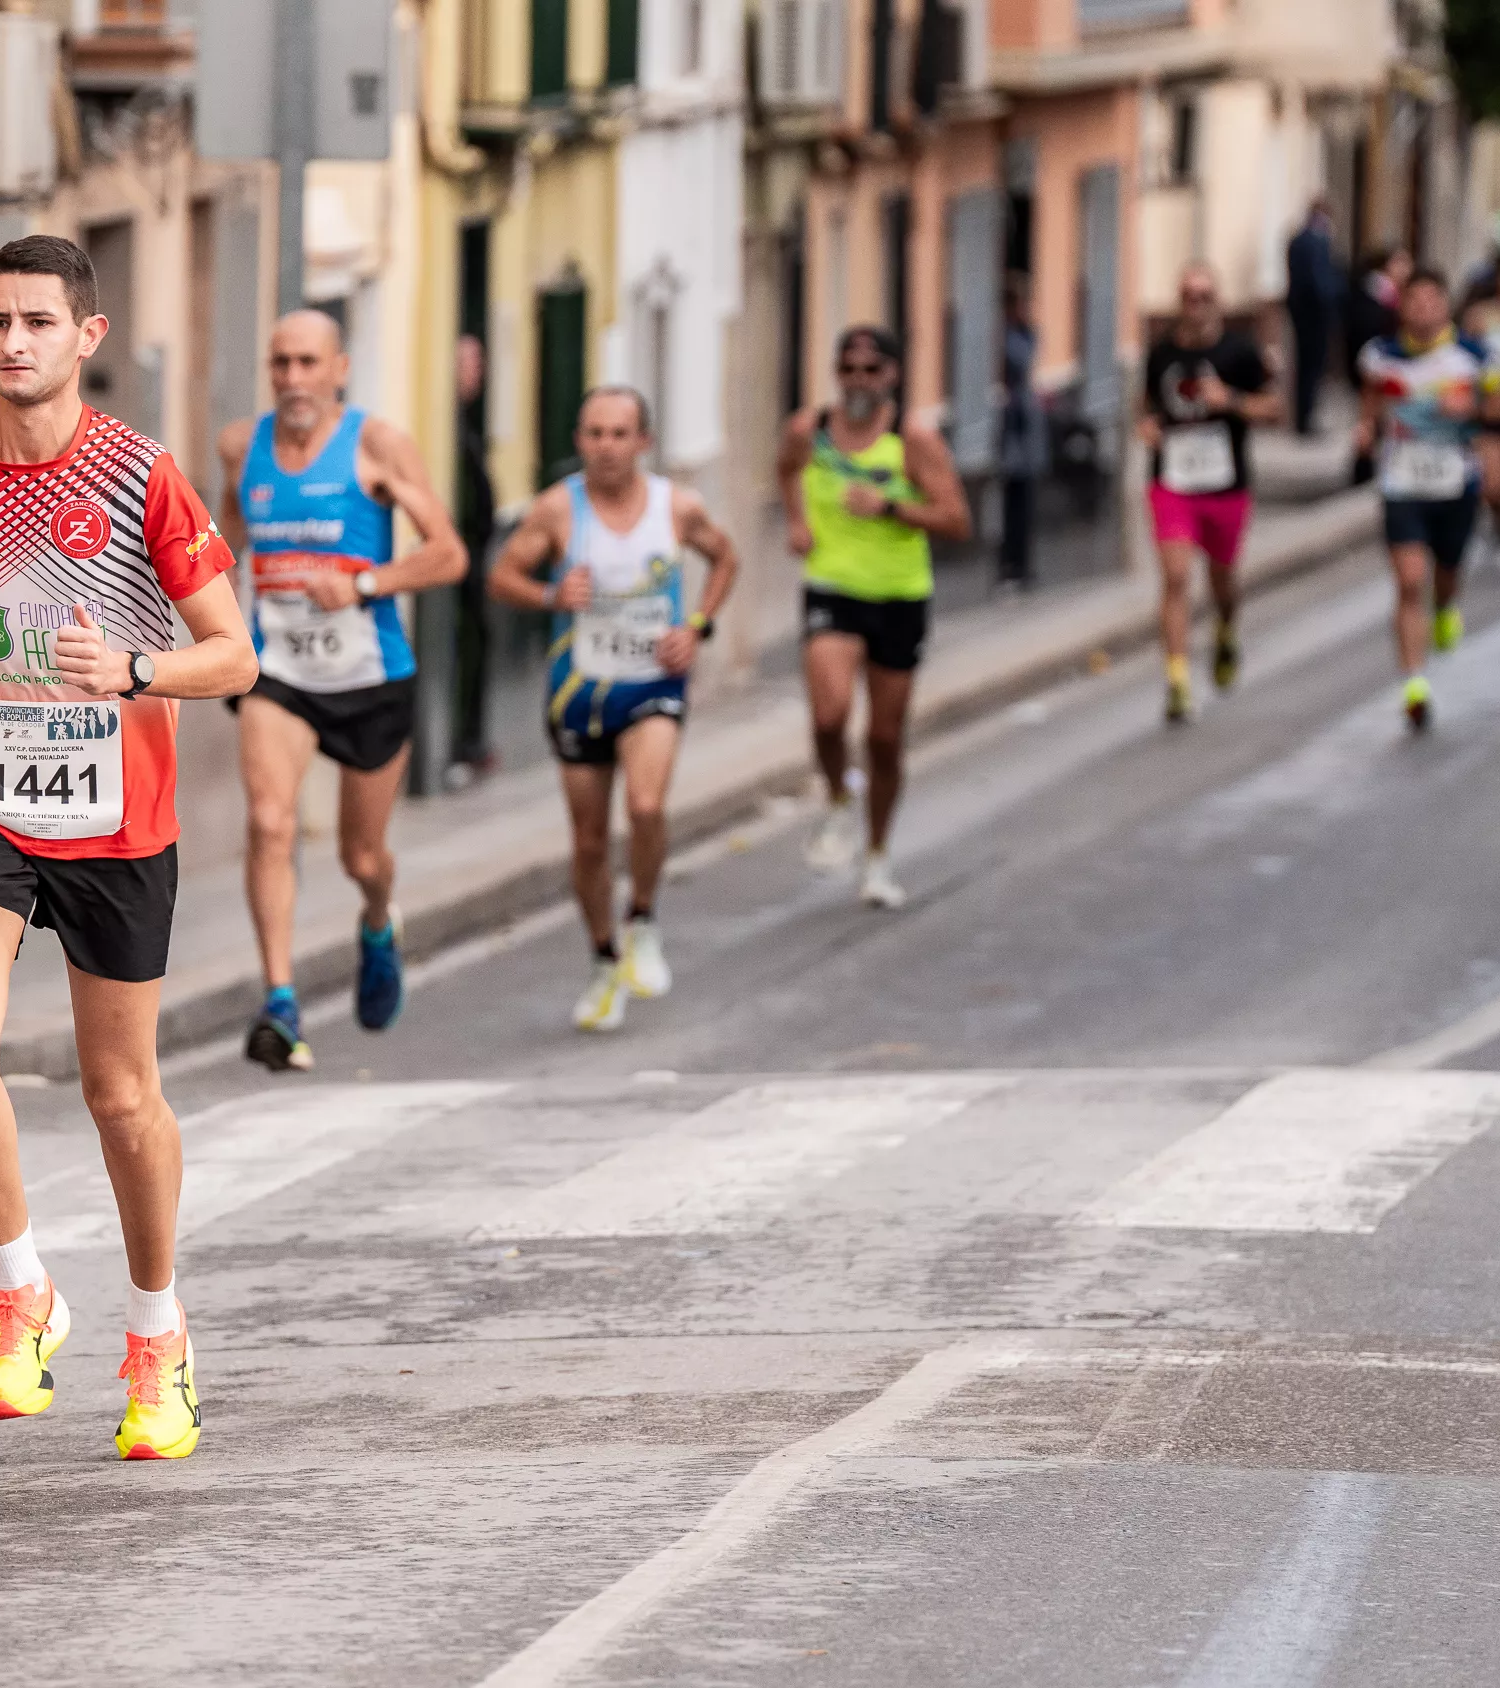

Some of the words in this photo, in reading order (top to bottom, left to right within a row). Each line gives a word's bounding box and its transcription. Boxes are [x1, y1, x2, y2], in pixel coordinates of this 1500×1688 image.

[58, 503, 68, 513] LA
[68, 499, 102, 513] ZANCADA
[19, 599, 104, 629] FUNDACÓN
[7, 714, 45, 722] POPULARES
[47, 706, 87, 722] 2024
